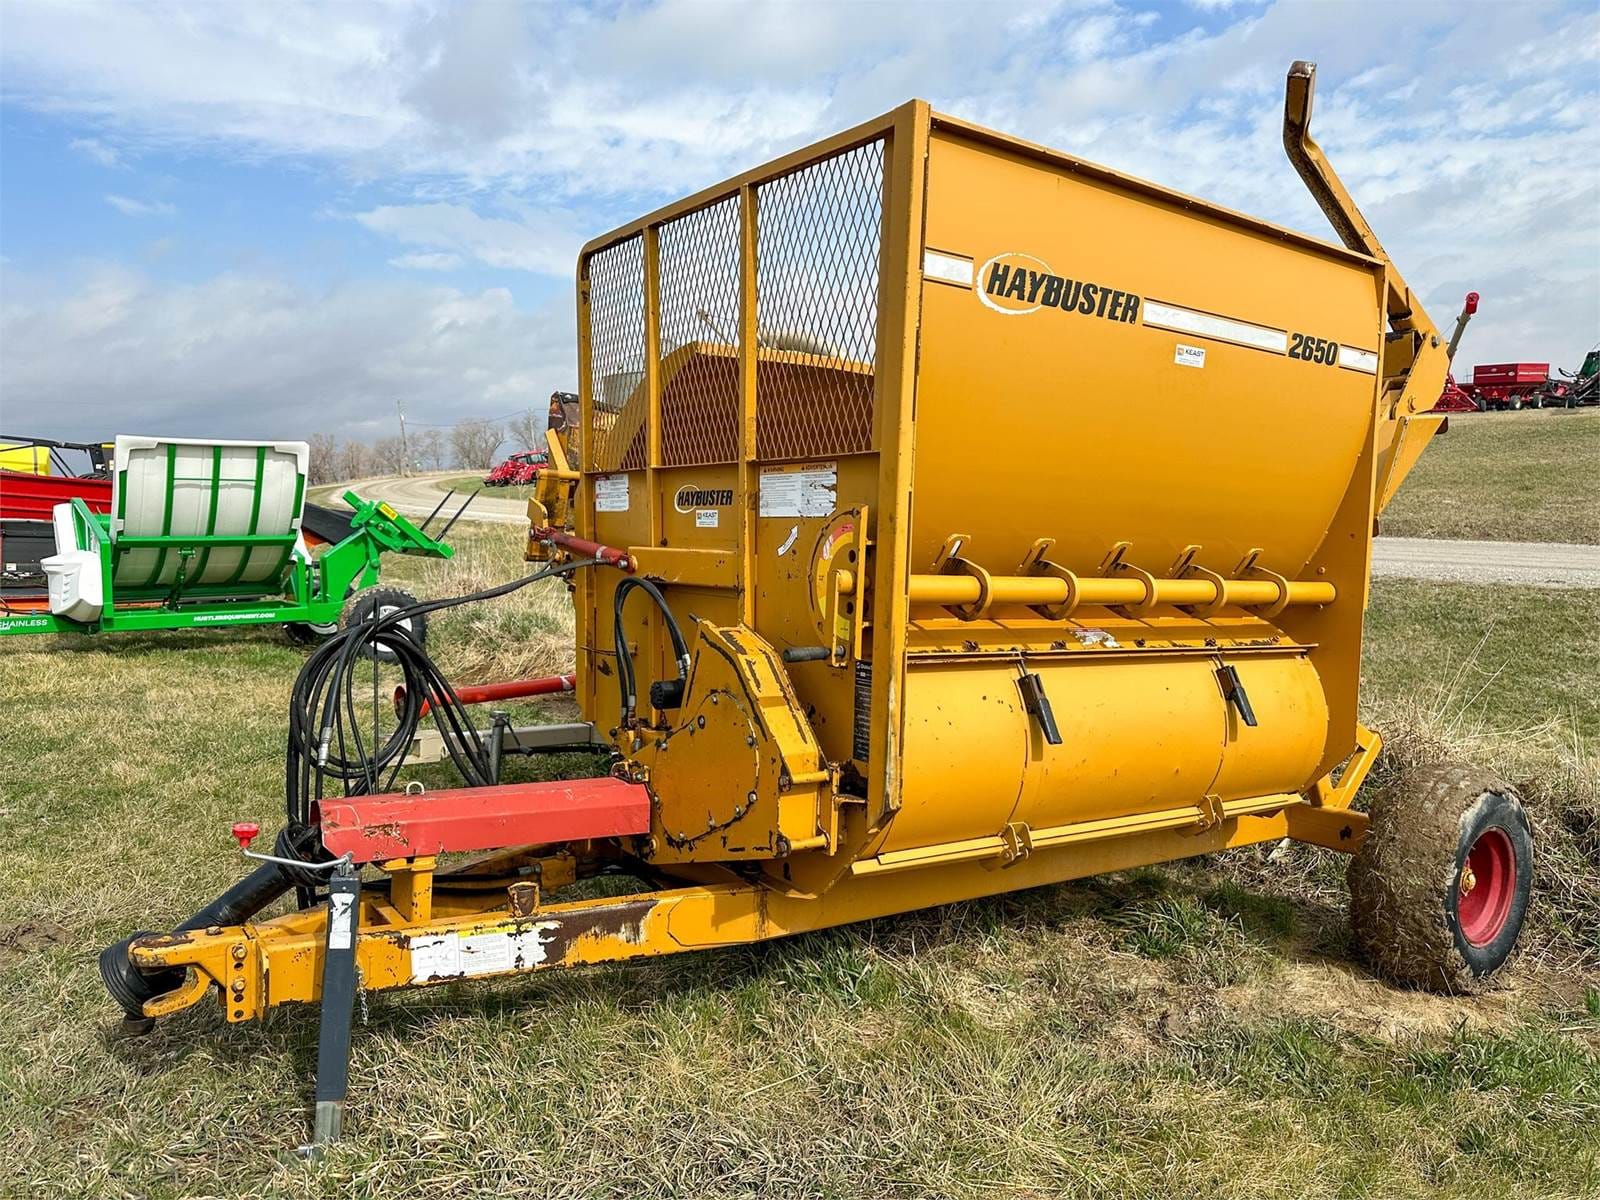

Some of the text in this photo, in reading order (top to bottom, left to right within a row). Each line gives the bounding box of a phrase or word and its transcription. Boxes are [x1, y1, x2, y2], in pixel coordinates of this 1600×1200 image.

[986, 262, 1140, 324] HAYBUSTER
[1185, 348, 1205, 357] KEAST
[1288, 332, 1339, 366] 2650
[677, 489, 734, 507] HAYBUSTER
